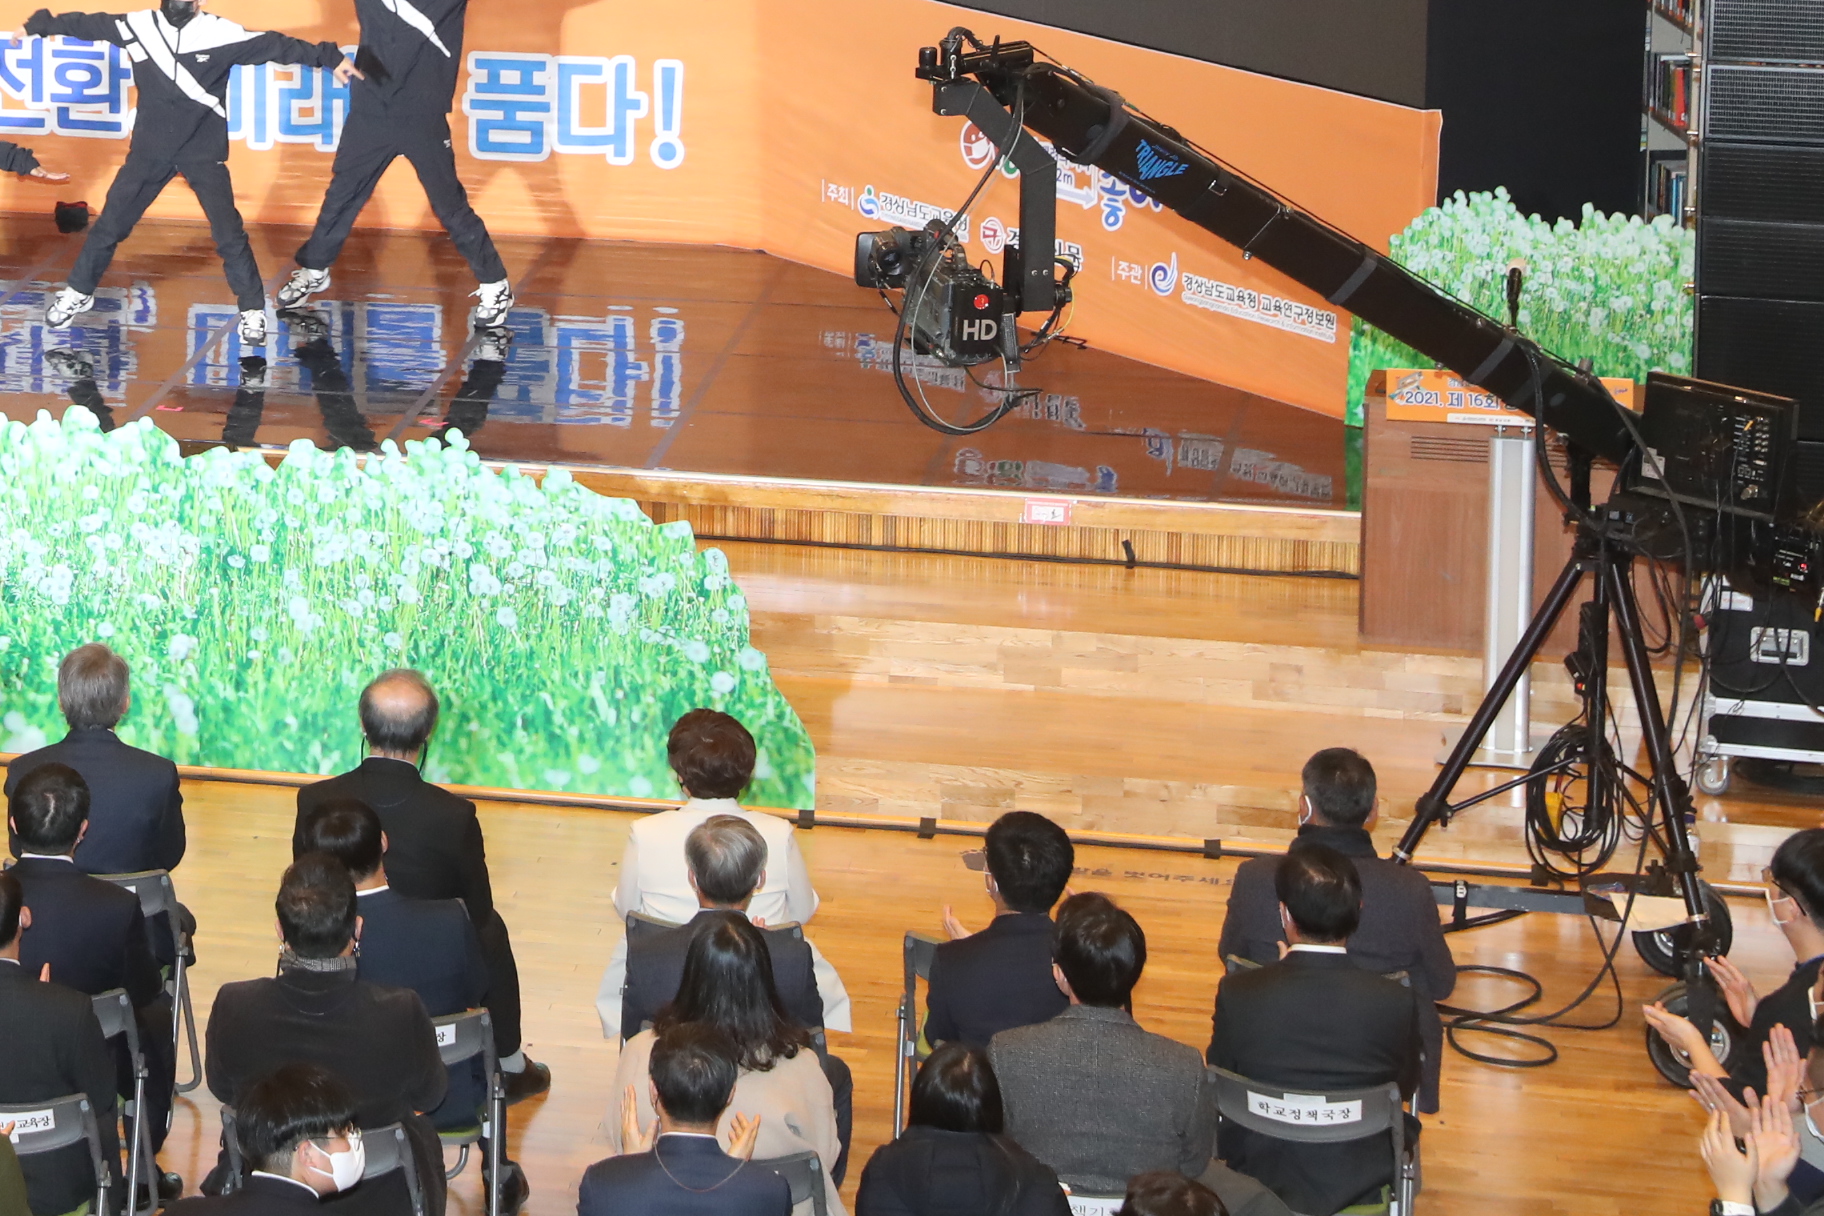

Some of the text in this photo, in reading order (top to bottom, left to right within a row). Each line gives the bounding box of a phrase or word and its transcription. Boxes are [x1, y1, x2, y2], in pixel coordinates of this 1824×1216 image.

[468, 55, 680, 165] 품다!
[1136, 138, 1189, 180] TRIANGLE
[826, 184, 849, 205] 주최
[1117, 261, 1142, 284] 주관
[1183, 274, 1336, 330] 경상남도교육청 교육연구정보원
[962, 319, 998, 341] HD
[1405, 391, 1443, 406] 2021.
[1447, 392, 1463, 407] 제
[1257, 1100, 1351, 1121] 학교정책국장
